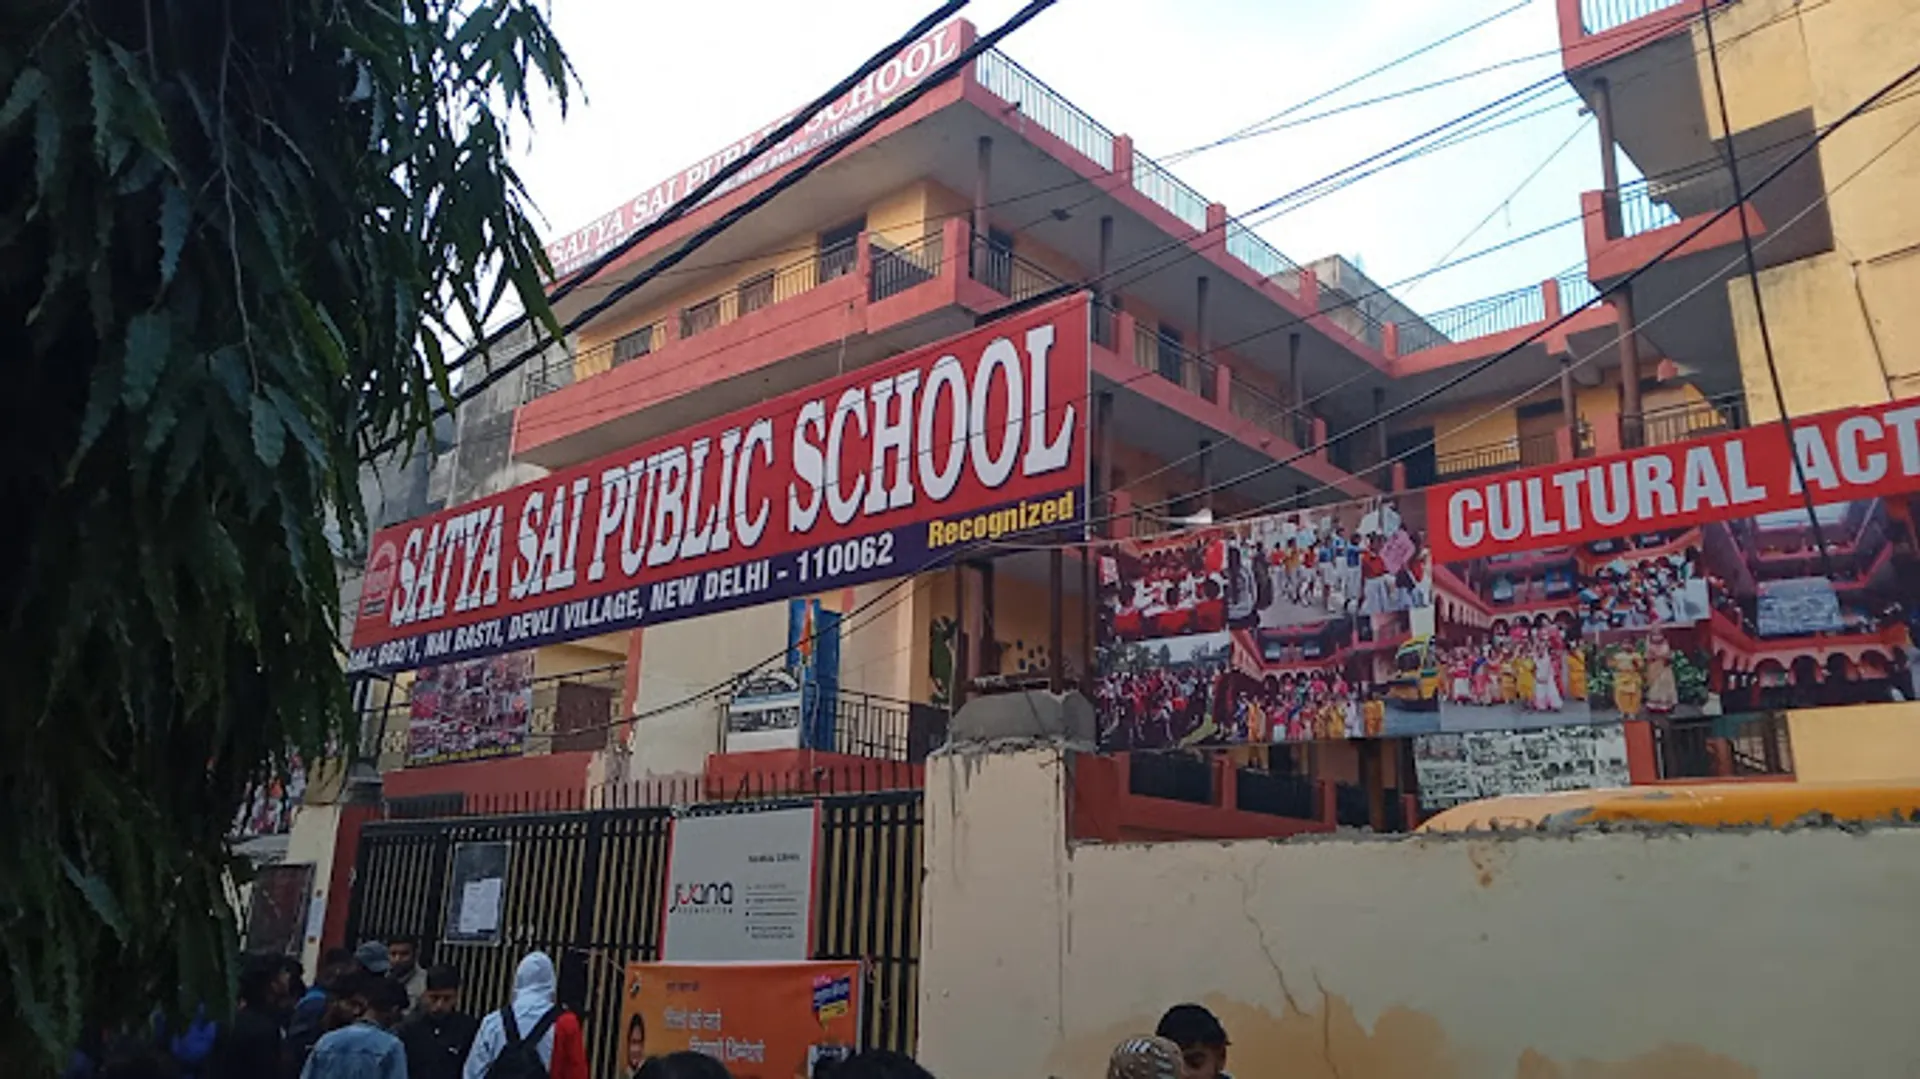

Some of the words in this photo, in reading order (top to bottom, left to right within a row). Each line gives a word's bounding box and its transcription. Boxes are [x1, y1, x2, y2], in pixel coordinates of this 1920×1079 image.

[549, 206, 627, 264] SATYA
[631, 177, 680, 226] SAI
[389, 505, 504, 627] SATYA
[509, 477, 591, 600] SAI
[587, 417, 774, 582] PUBLIC
[788, 324, 1076, 532] SCHOOL
[928, 490, 1075, 549] Recognized
[1447, 439, 1766, 550] CULTURAL
[1788, 405, 1920, 494] ACT
[454, 618, 505, 652] BASTI,
[508, 609, 560, 641] DEVLI
[563, 587, 645, 630] VILLAGE,
[650, 575, 700, 612] NEW
[704, 559, 770, 600] DELHI
[796, 531, 895, 583] 110062
